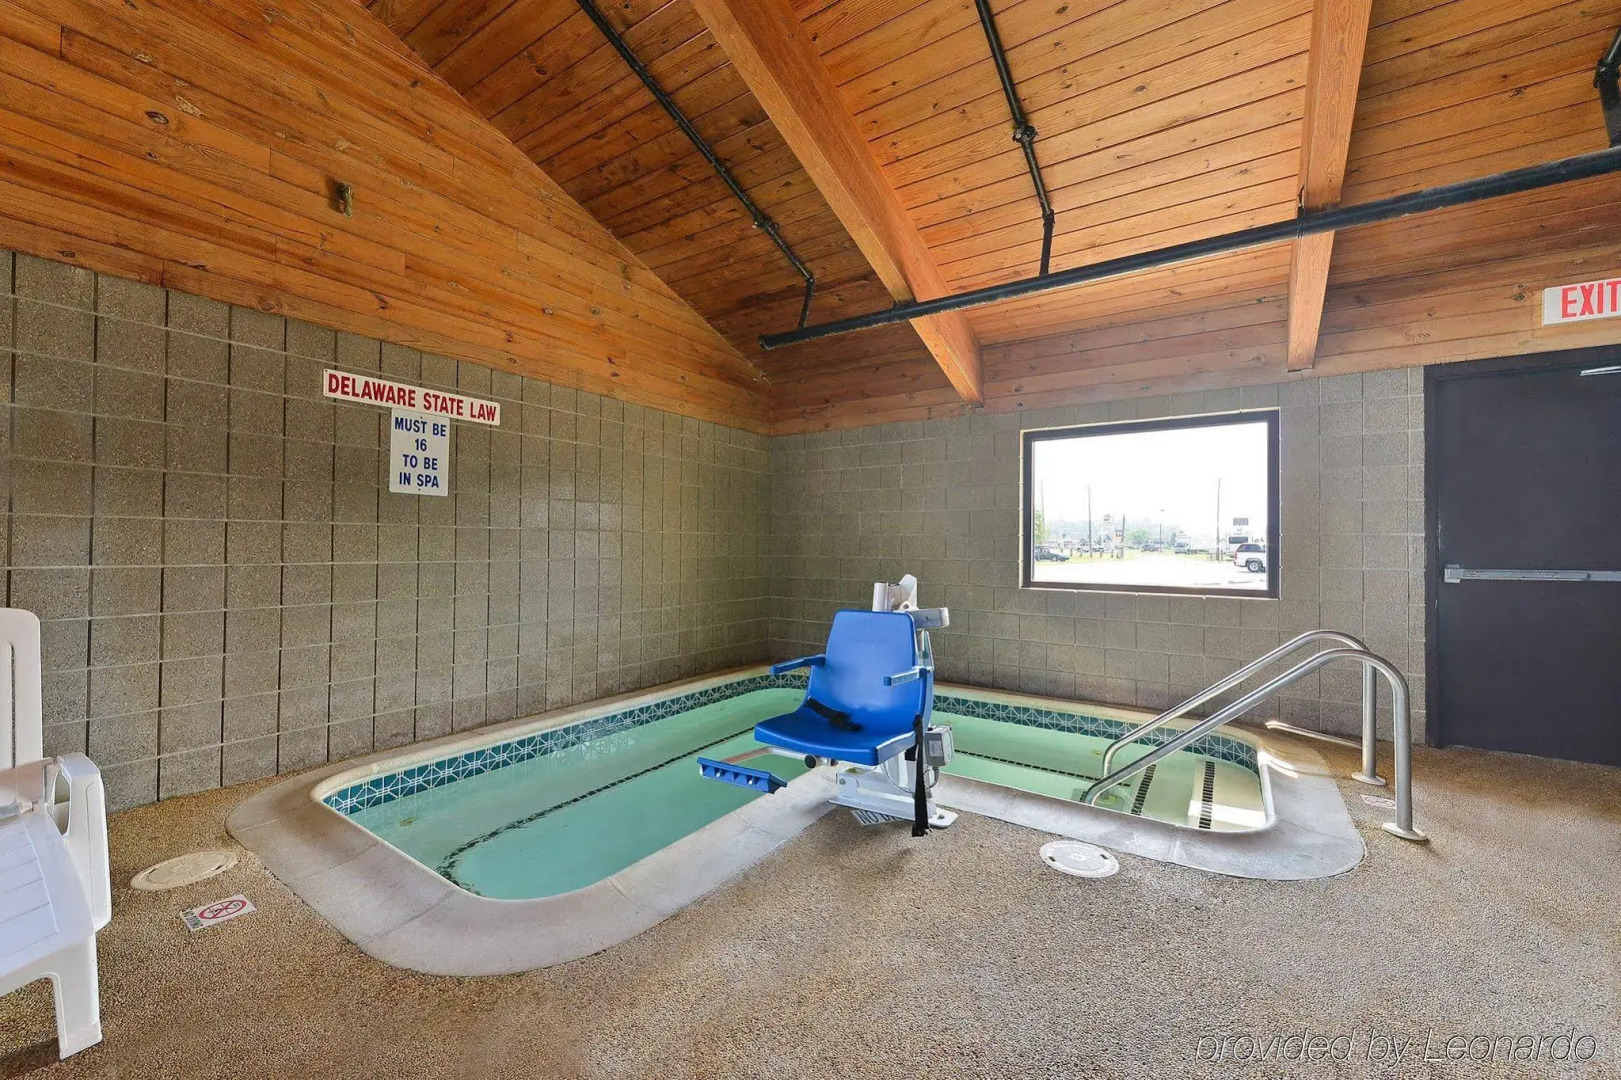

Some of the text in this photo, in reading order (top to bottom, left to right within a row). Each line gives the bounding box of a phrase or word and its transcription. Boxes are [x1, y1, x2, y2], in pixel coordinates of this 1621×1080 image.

[1562, 281, 1621, 318] EXIT
[328, 373, 497, 422] DELAWARE STATE LAW
[394, 416, 447, 437] MUST BE
[414, 438, 427, 452] 16
[402, 454, 438, 470] TO BE
[399, 472, 439, 488] IN SPA
